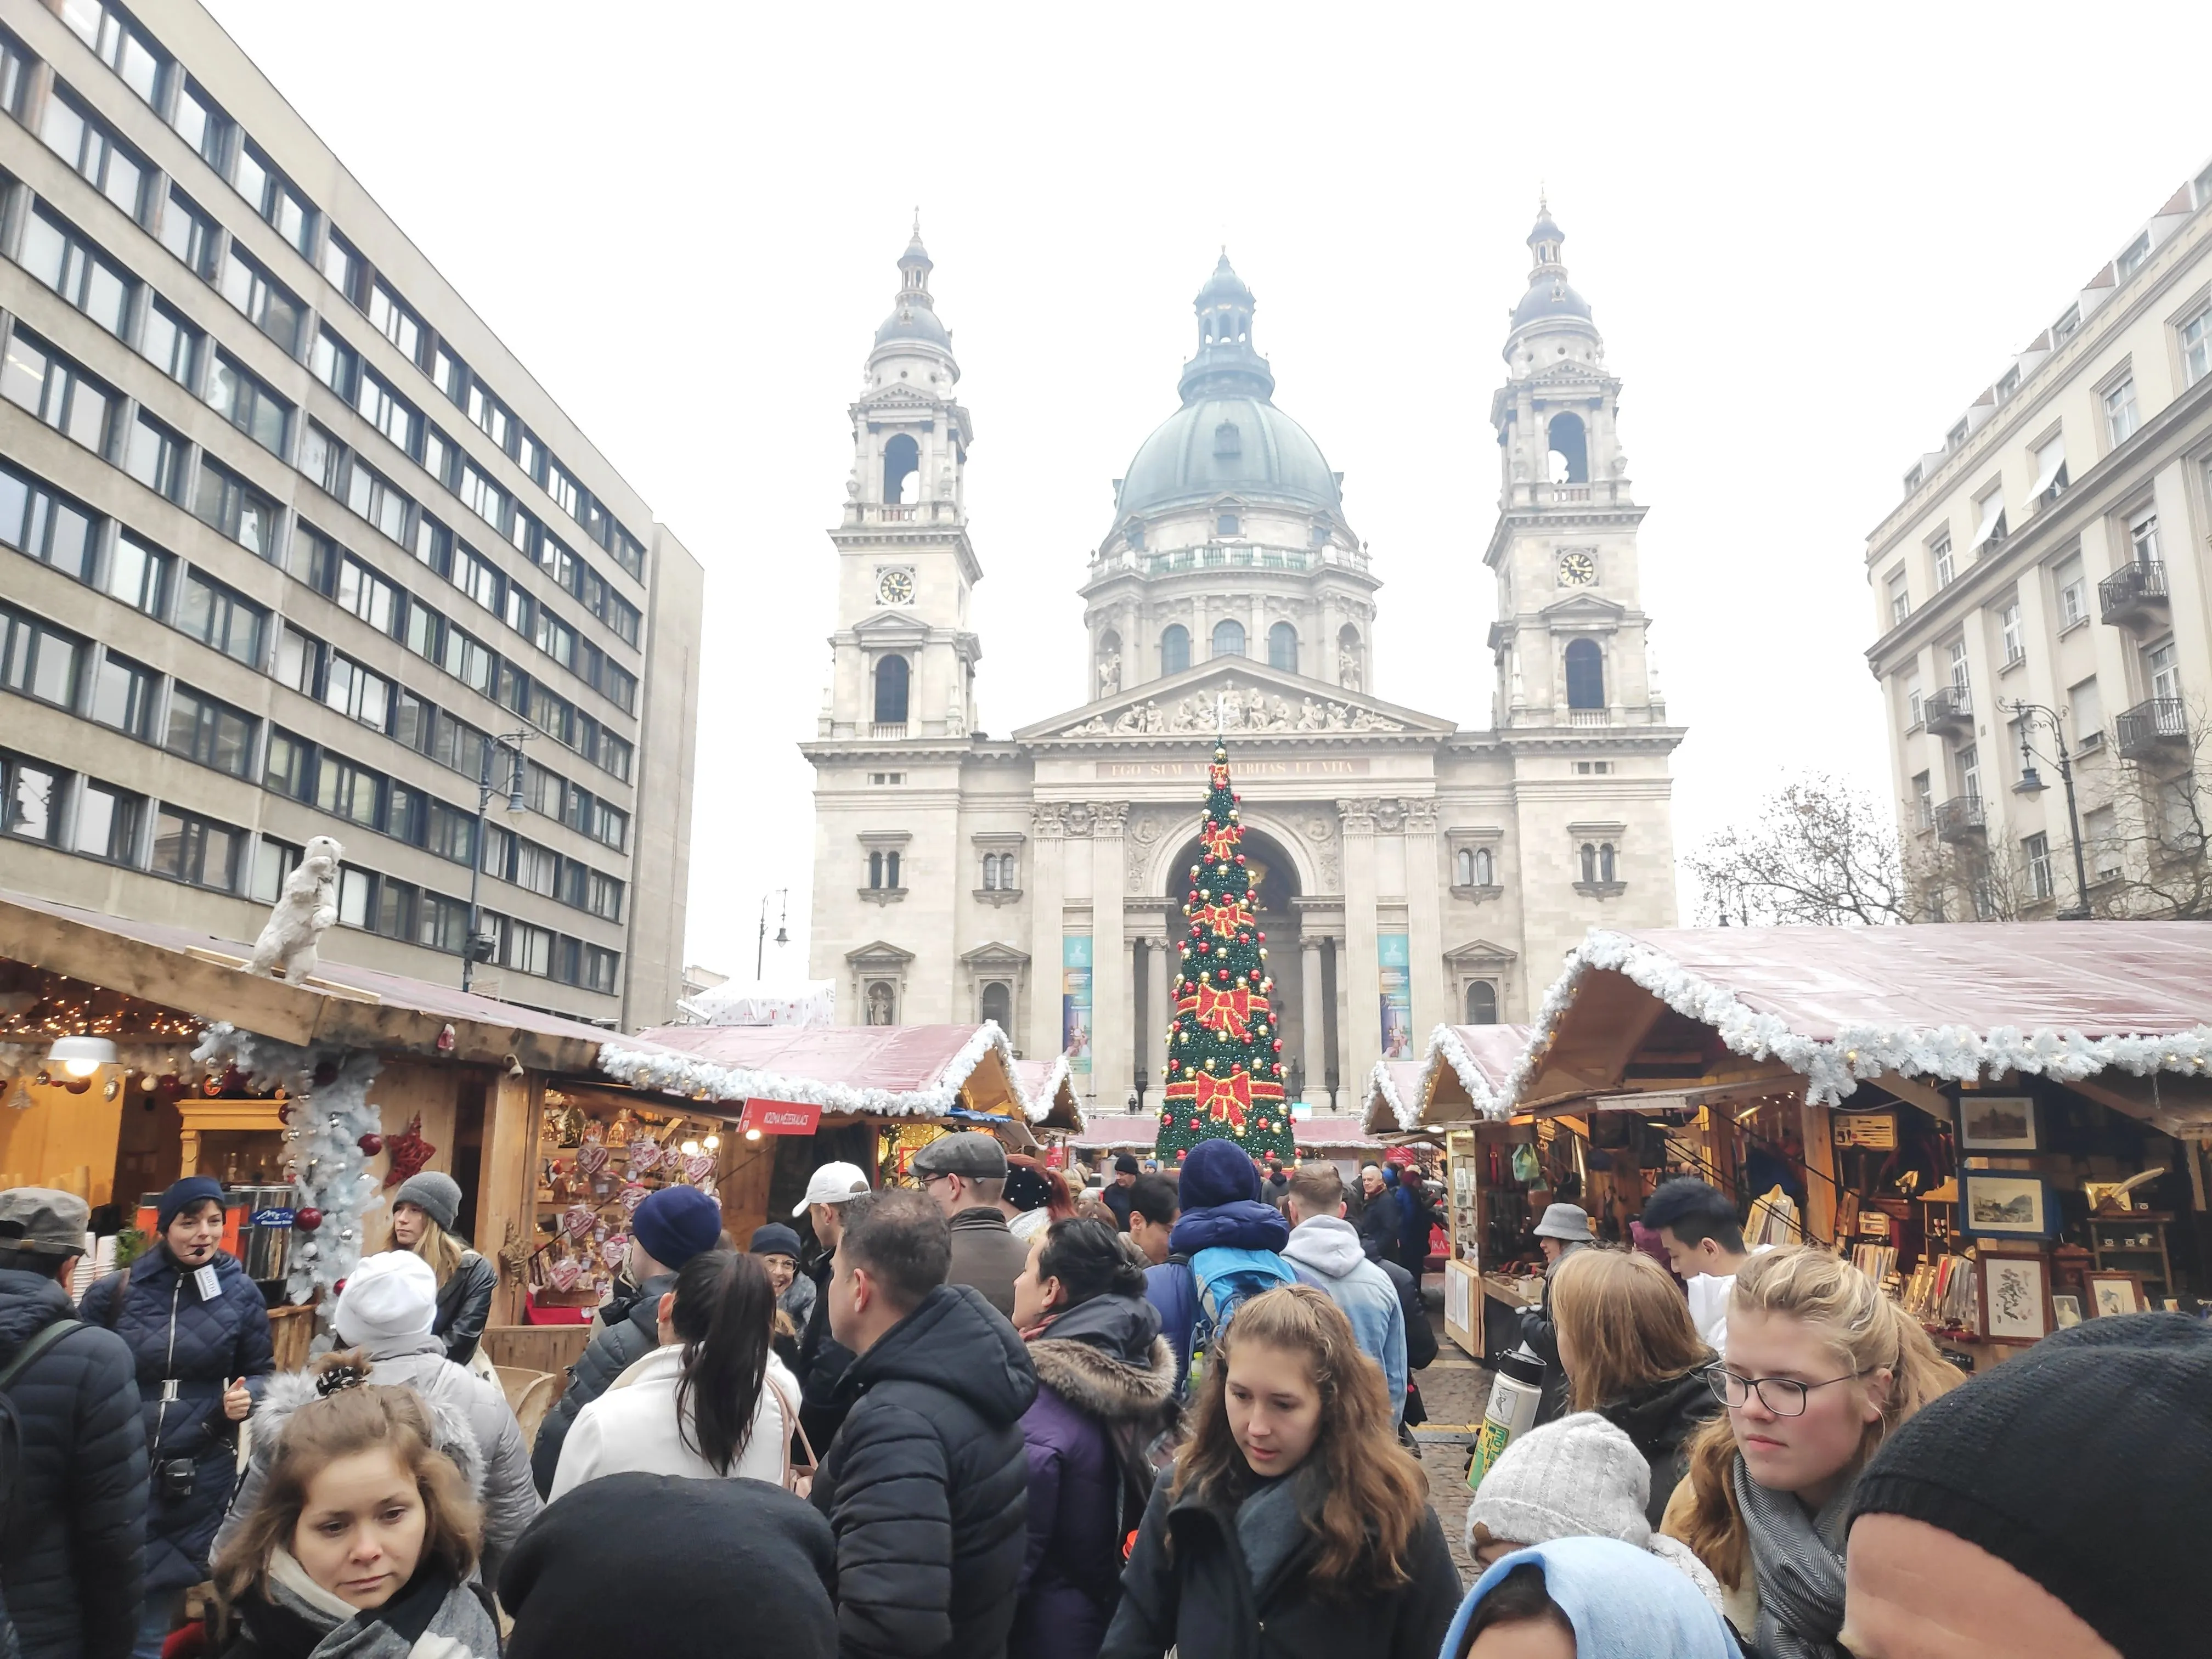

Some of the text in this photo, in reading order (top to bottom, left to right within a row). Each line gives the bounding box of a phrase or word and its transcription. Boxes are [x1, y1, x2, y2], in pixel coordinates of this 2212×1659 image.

[1111, 764, 1141, 776] EGO
[1150, 763, 1182, 775] SUM
[1228, 761, 1286, 775] VERITAS
[1295, 761, 1312, 774] ET
[1322, 761, 1353, 772] VITA
[742, 1119, 750, 1131] 99
